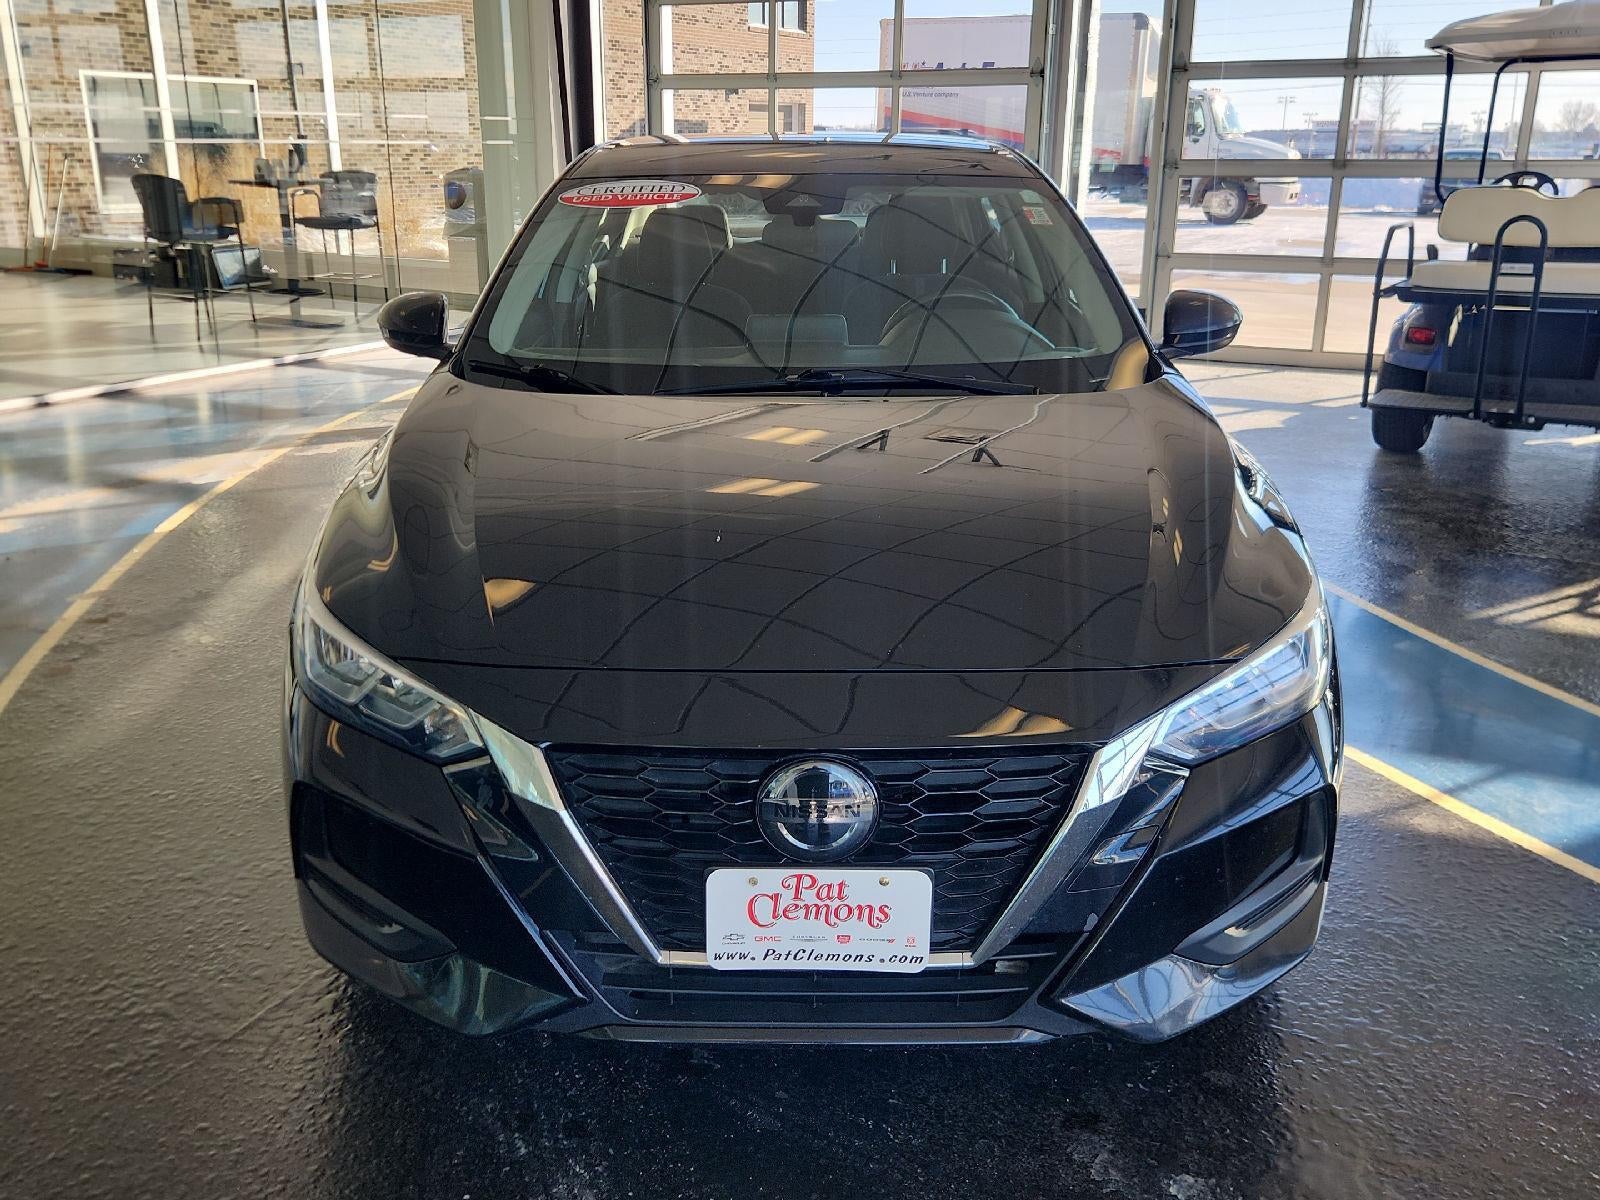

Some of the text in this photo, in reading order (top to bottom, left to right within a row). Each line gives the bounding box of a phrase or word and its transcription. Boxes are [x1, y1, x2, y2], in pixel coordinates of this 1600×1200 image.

[572, 193, 682, 203] USED VEHICLE
[577, 184, 686, 196] CERTIFIED
[781, 873, 849, 901] Pat
[747, 892, 892, 929] Clemons
